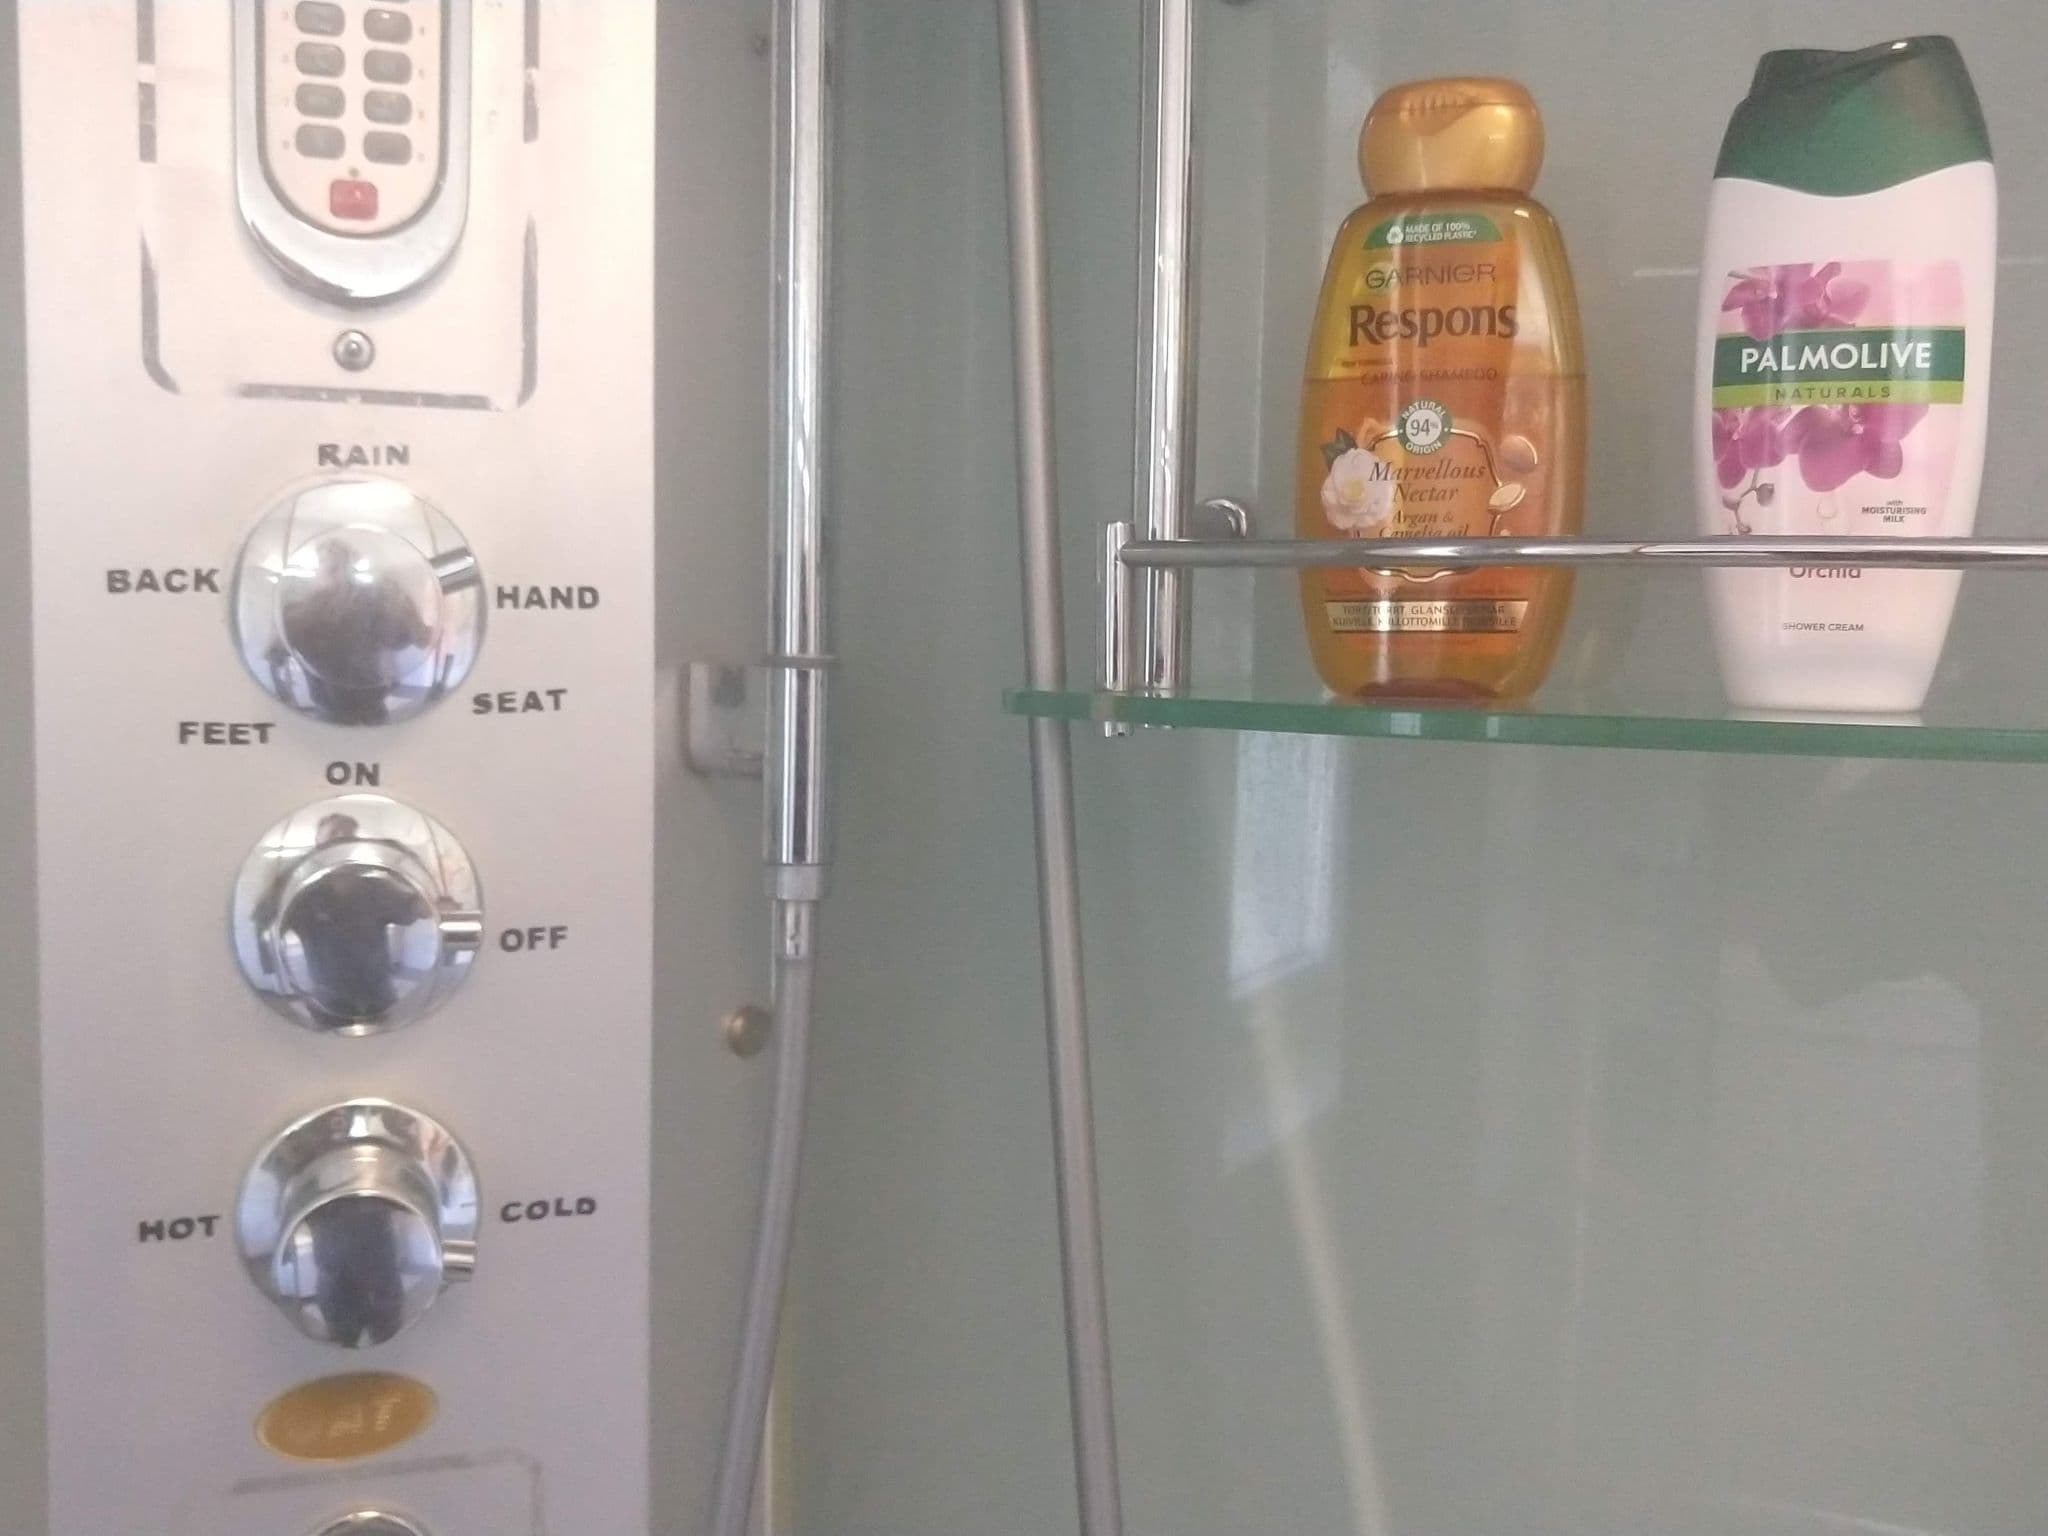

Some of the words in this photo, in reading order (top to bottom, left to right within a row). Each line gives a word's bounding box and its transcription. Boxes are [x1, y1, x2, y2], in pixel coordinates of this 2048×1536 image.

[1405, 223, 1430, 234] MADE
[1431, 223, 1443, 232] OF
[1405, 232, 1443, 243] RECYCLED
[1365, 262, 1497, 290] GARNIER
[1348, 304, 1520, 348] Respons
[1741, 342, 1933, 374] PALMOLIVE
[1775, 386, 1891, 402] NATURALS
[1401, 400, 1446, 420] NATURAL
[317, 443, 410, 467] RAIN
[1405, 440, 1443, 455] ORIGIN
[1368, 458, 1487, 482] Marvellous
[1392, 482, 1459, 503] Nectar
[1392, 509, 1438, 529] Argan
[1861, 506, 1927, 515] MOISTURISING
[1883, 515, 1905, 523] MILK
[107, 568, 220, 594] BACK
[496, 586, 600, 610] HAND
[1783, 622, 1825, 632] SHOWER
[1828, 623, 1864, 632] CREAM
[472, 689, 567, 715] SEAT
[179, 722, 275, 745] FEET
[325, 762, 380, 787] ON
[500, 926, 569, 953] OFF
[500, 1196, 597, 1223] COLD
[139, 1215, 221, 1243] HOT
